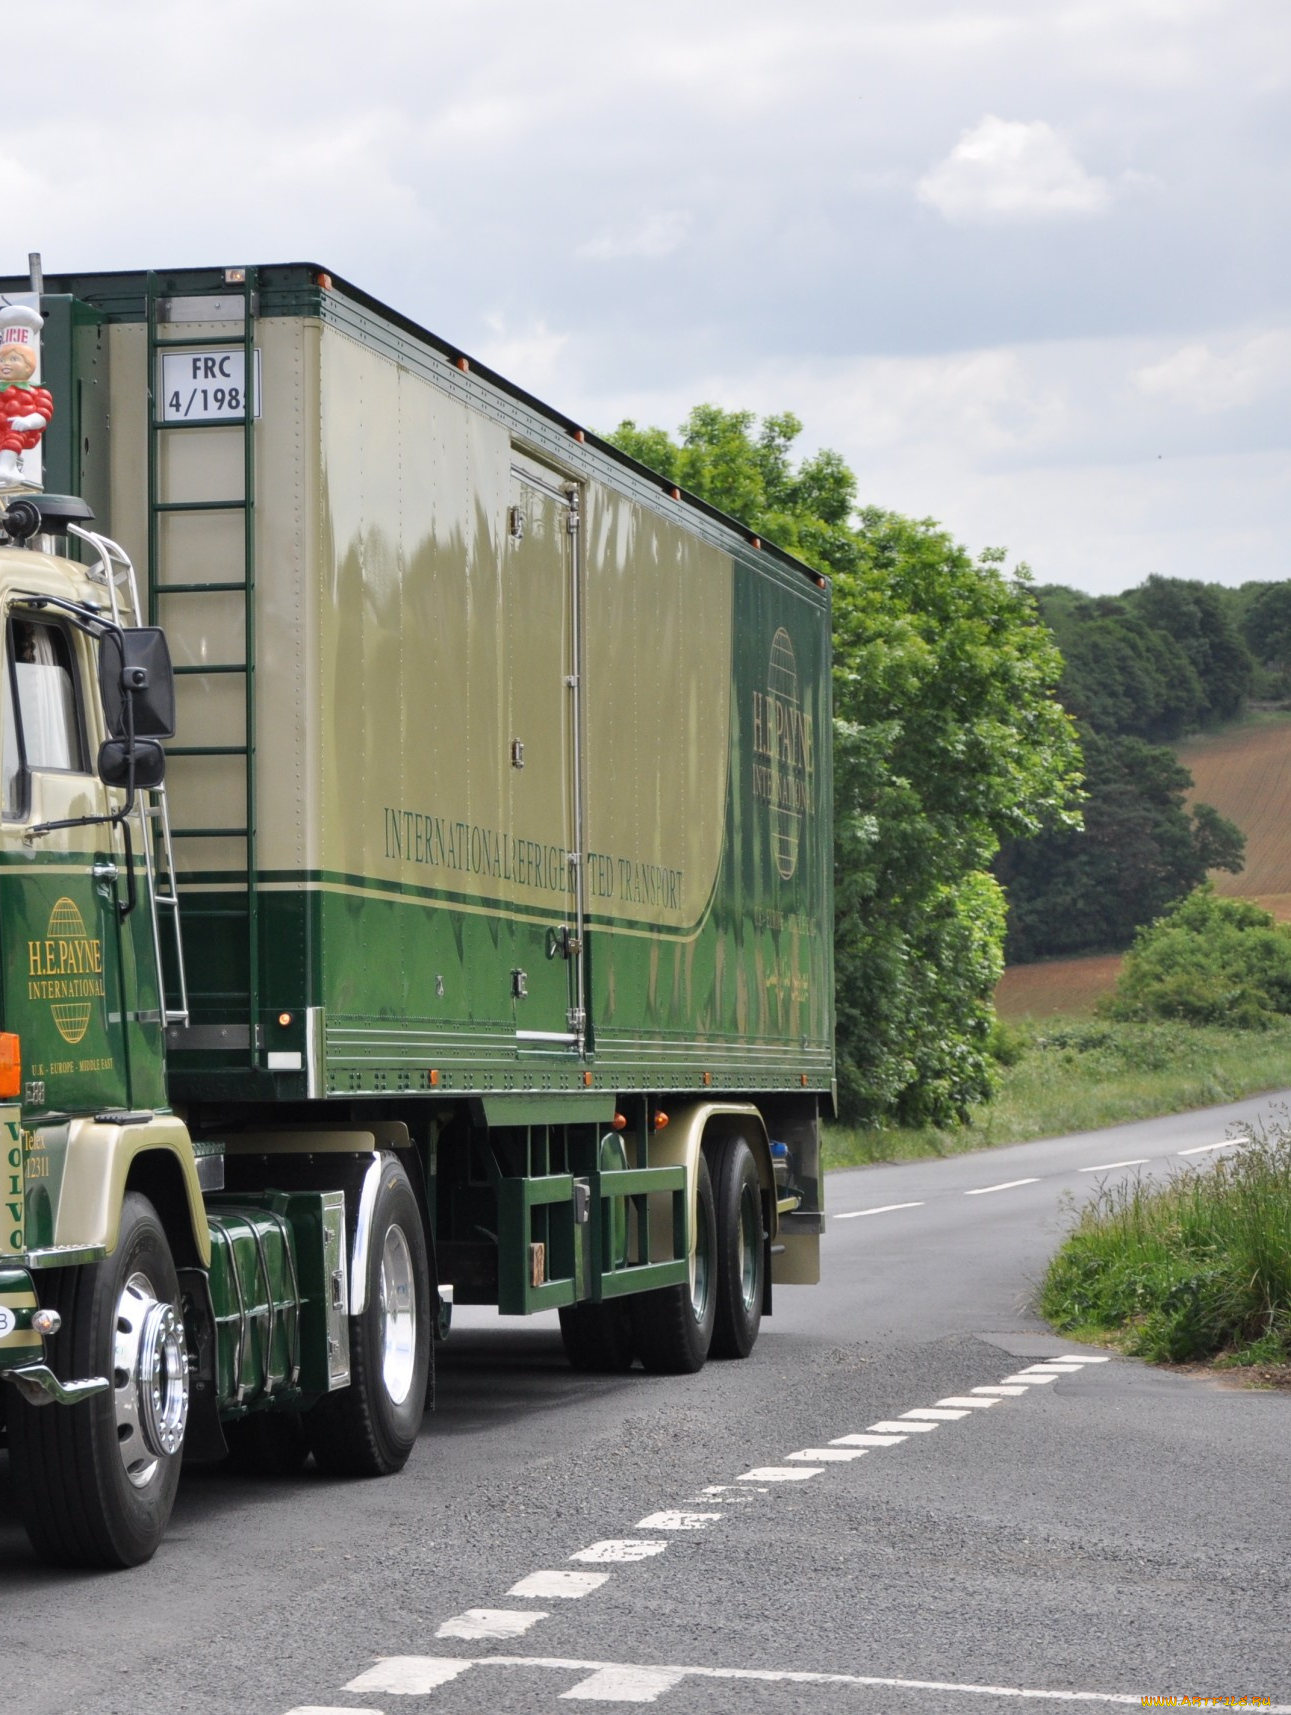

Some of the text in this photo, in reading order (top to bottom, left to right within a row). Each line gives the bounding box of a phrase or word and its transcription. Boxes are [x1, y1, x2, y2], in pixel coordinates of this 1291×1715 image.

[192, 356, 231, 379] FRC
[168, 387, 245, 417] 4/198
[752, 762, 815, 815] INTERNATION
[384, 807, 683, 911] INTERNATIONAL REFRIGERTED TRANSPORT
[27, 939, 102, 976] H.E.PAYNE
[28, 979, 106, 1000] INTERNATIONAL
[50, 1061, 74, 1074] EUROPE
[79, 1058, 100, 1072] MIDDLE
[101, 1057, 113, 1070] EAST
[24, 1129, 46, 1151] Telex
[24, 1156, 49, 1179] 12311
[4, 1121, 23, 1250] VOLVO
